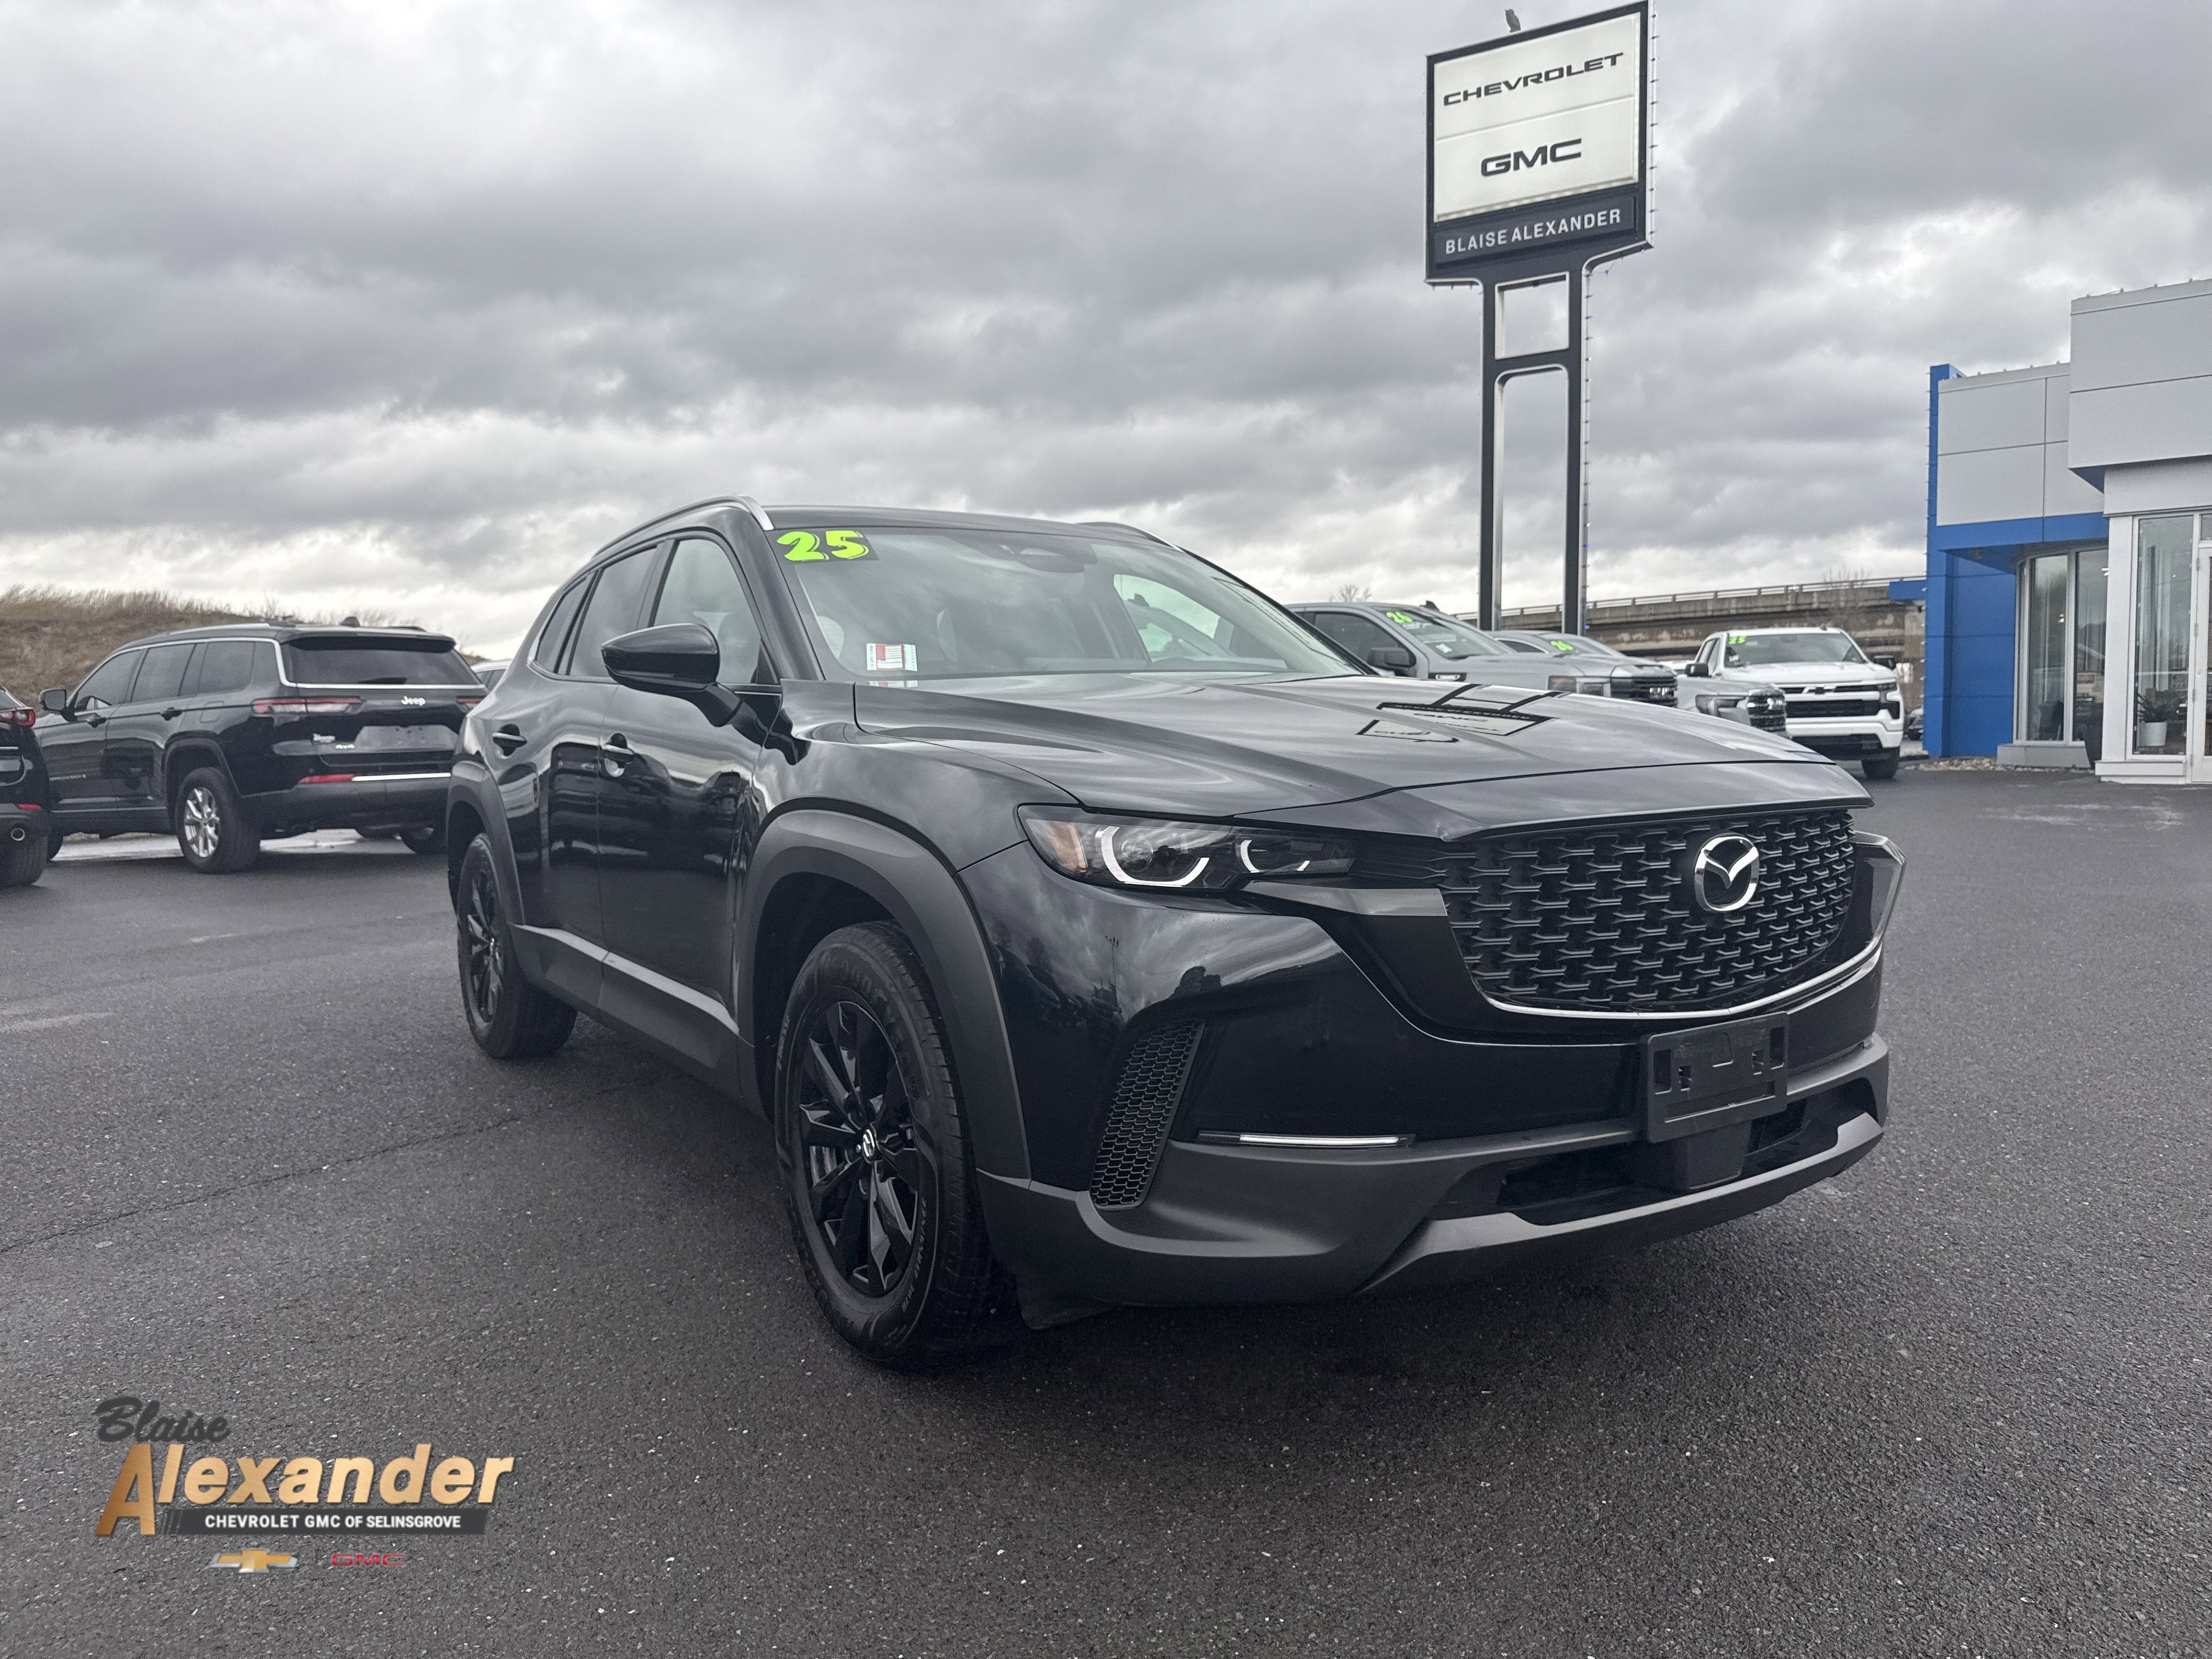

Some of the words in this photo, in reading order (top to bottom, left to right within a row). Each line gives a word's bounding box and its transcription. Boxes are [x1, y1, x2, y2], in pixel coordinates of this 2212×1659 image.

[1443, 52, 1624, 106] CHEVROLET
[1481, 138, 1582, 177] GMC
[1446, 229, 1508, 255] BLAISE
[1511, 208, 1621, 242] ALEXANDER
[776, 530, 870, 562] 25
[401, 695, 426, 707] Jeep
